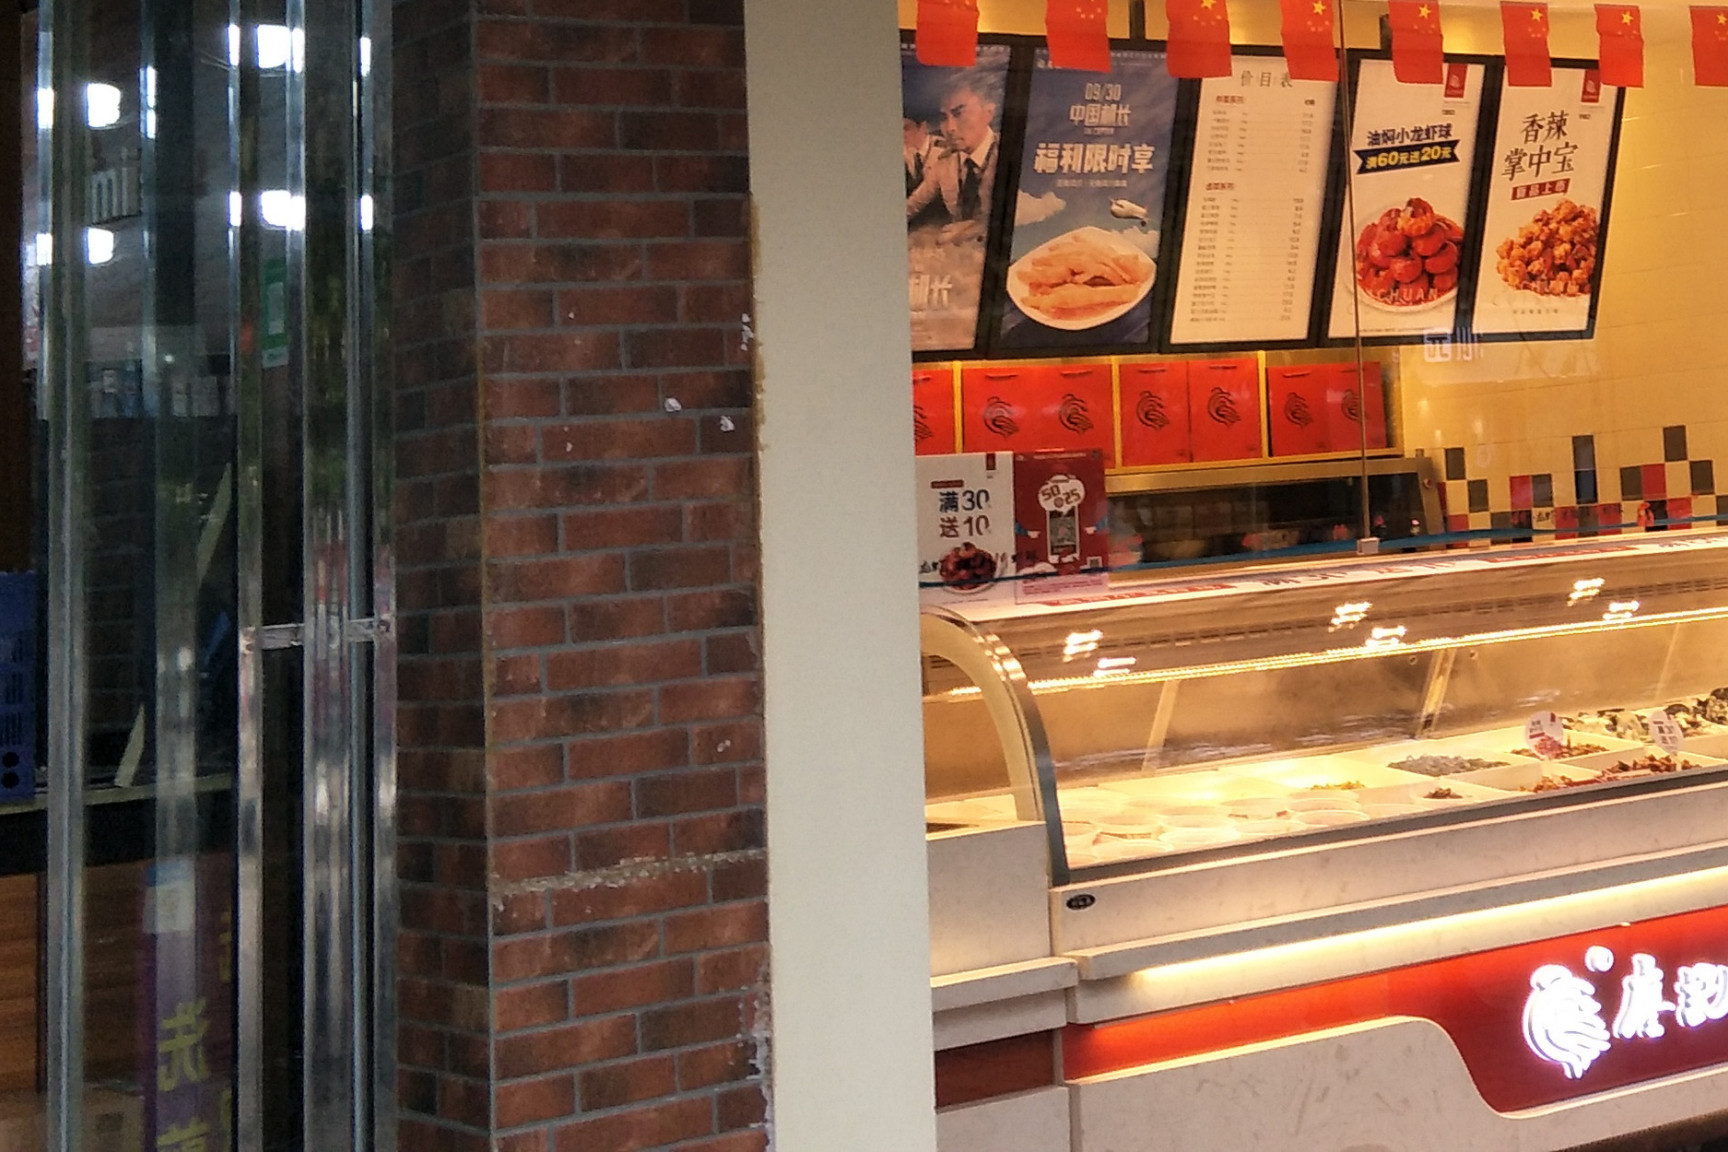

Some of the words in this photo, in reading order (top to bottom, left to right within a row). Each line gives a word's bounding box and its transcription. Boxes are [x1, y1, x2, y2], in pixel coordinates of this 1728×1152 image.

[1366, 123, 1453, 146] 油焖小龙虾球
[1521, 110, 1569, 144] 香辣
[1033, 142, 1155, 174] 福利限时享
[1501, 141, 1579, 182] 掌中宝
